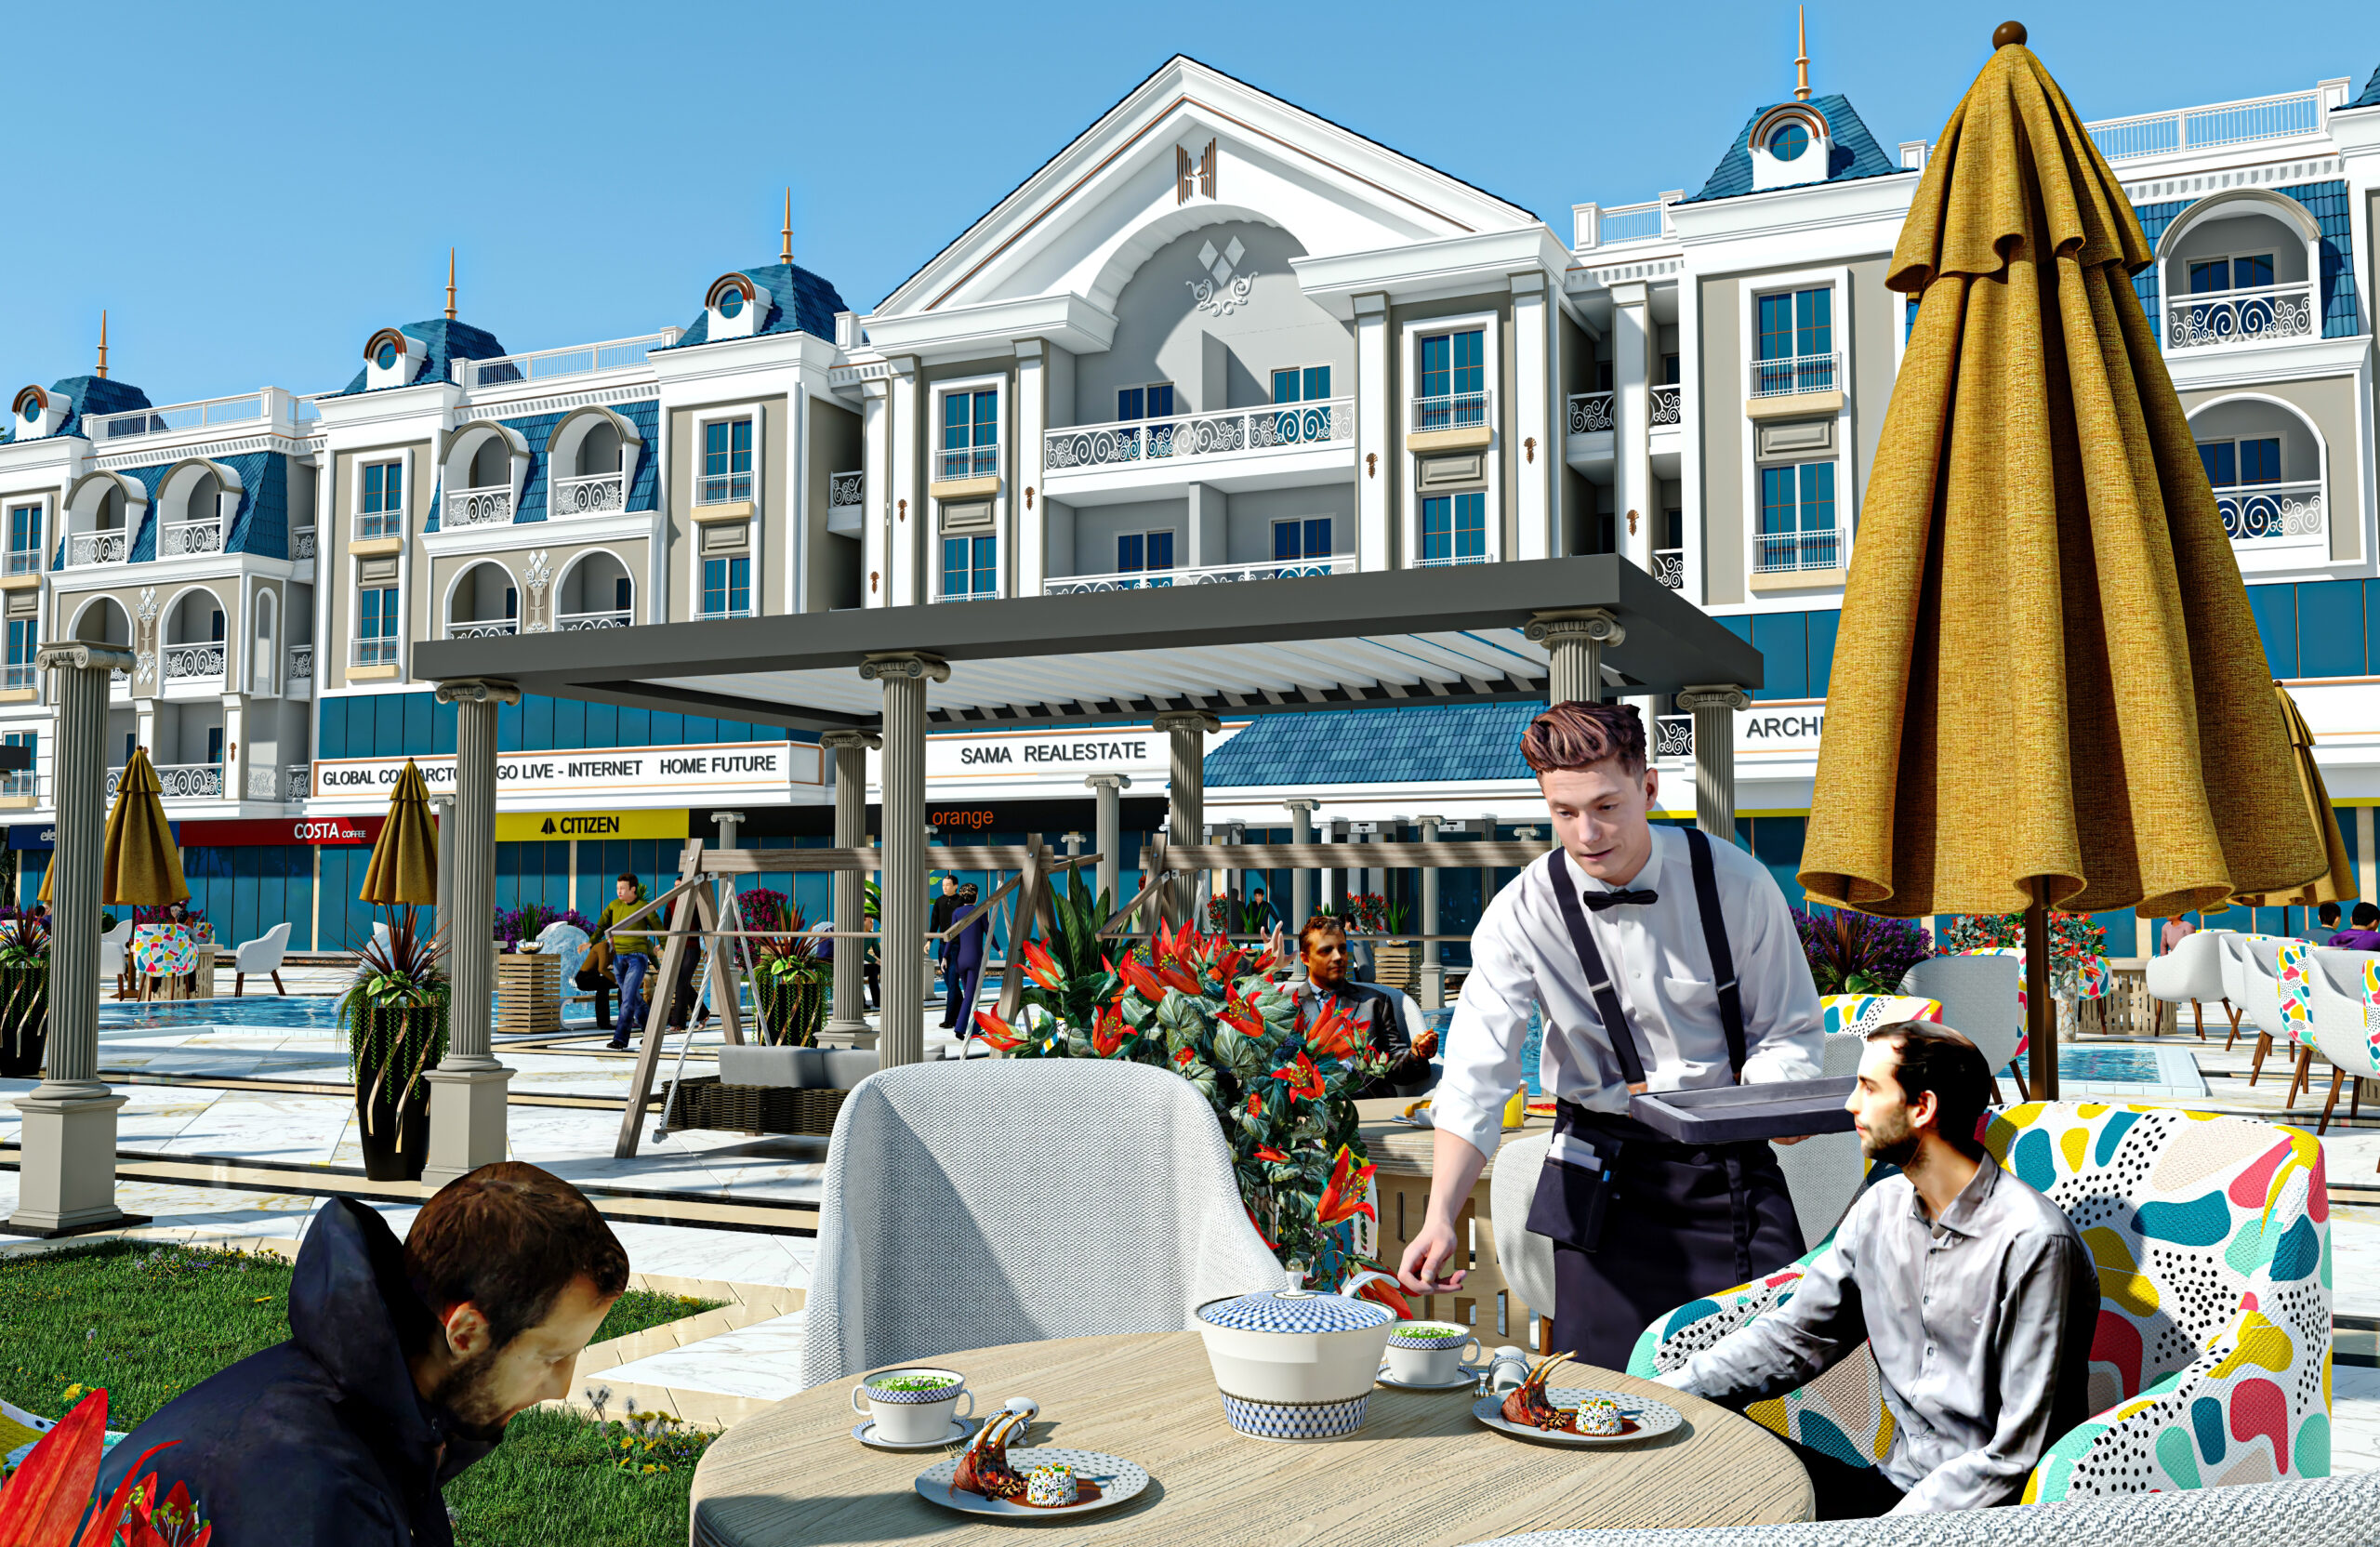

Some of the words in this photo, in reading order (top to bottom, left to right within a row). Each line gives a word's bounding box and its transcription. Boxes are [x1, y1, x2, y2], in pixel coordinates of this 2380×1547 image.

[961, 747, 1012, 764] SAMA
[1025, 741, 1146, 762] REALESTATE
[323, 770, 376, 786] GLOBAL
[522, 763, 554, 779] LIVE
[568, 760, 642, 777] INTERNET
[660, 758, 707, 774] HOME
[712, 755, 776, 773] FUTURE
[560, 816, 620, 834] CITIZEN
[932, 810, 994, 829] orange
[294, 822, 340, 840] COSTA
[341, 830, 366, 839] COFFEE
